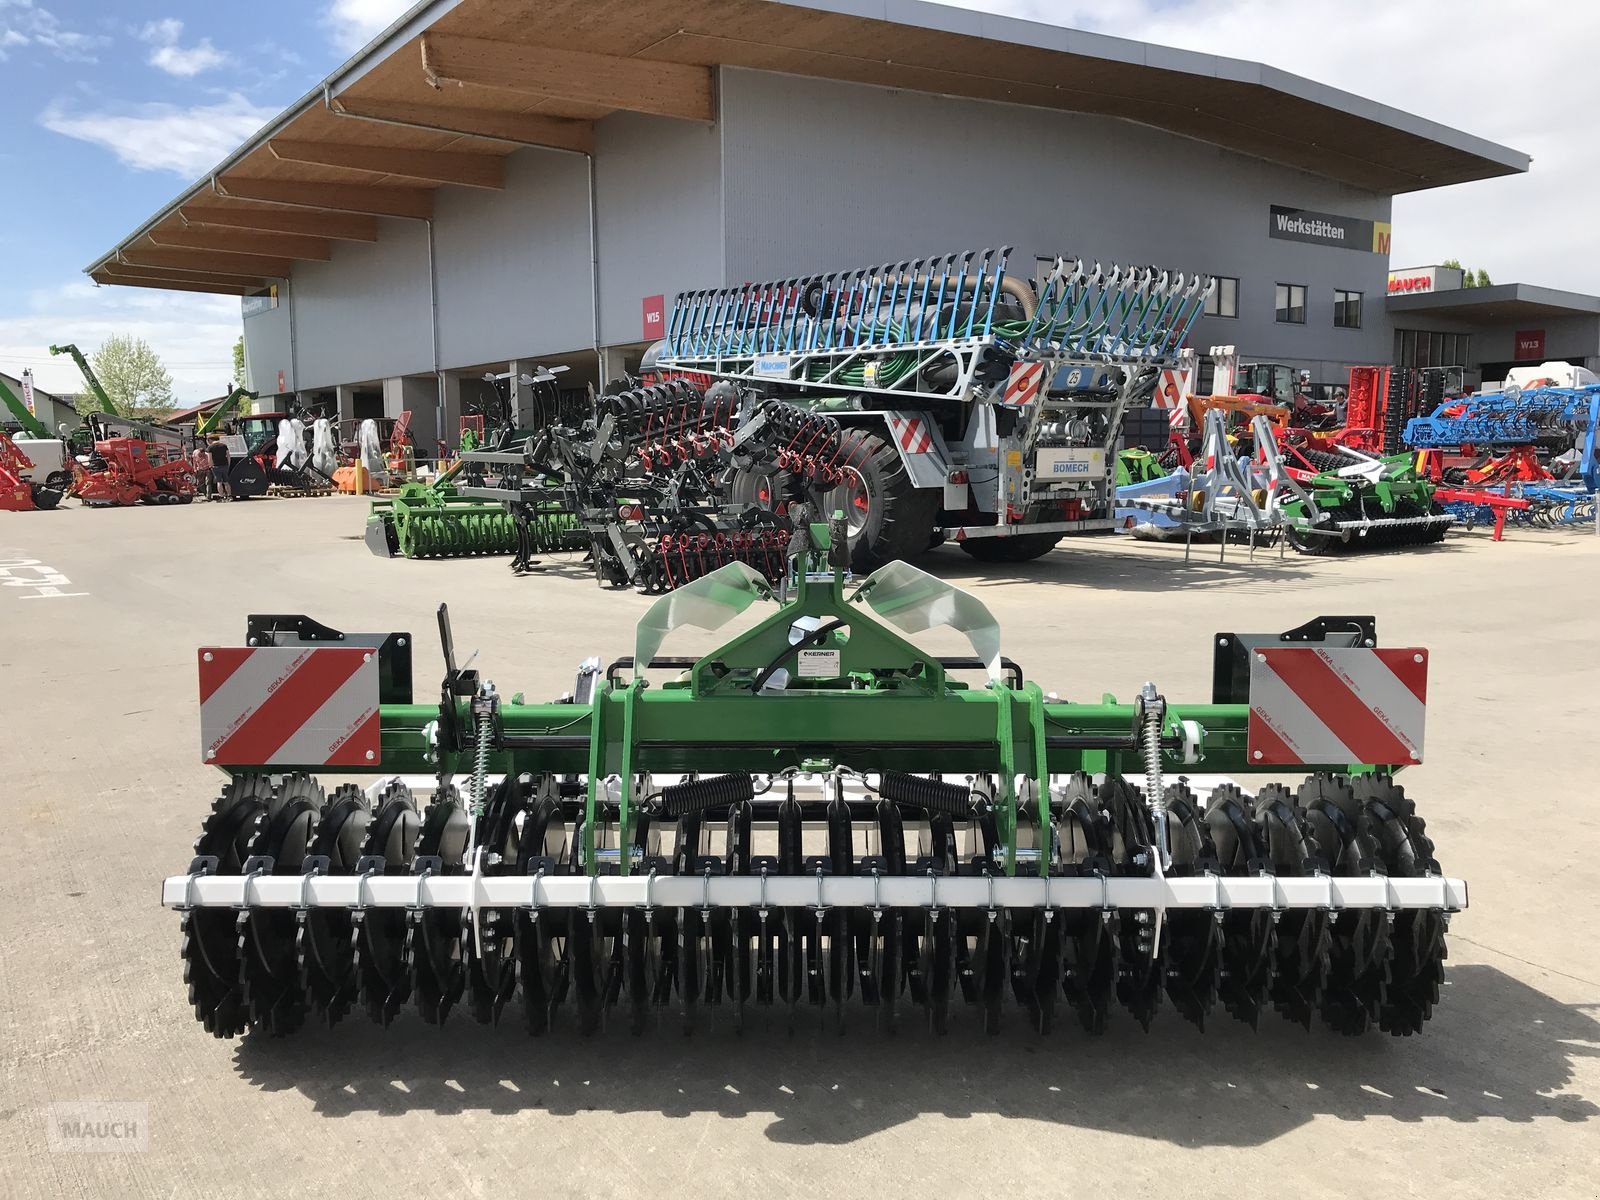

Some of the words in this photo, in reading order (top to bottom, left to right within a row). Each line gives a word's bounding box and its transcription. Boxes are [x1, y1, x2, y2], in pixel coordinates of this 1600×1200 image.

[1276, 213, 1345, 240] Werkstätten
[646, 311, 660, 324] W15
[1520, 340, 1539, 350] W13
[1068, 372, 1080, 384] 25
[1053, 463, 1089, 473] BOMECH
[1317, 648, 1333, 666] GEKA
[267, 676, 285, 694] GEKA
[1256, 706, 1272, 724] GEKA
[1373, 706, 1390, 725] GEKA
[328, 735, 346, 753] GEKA
